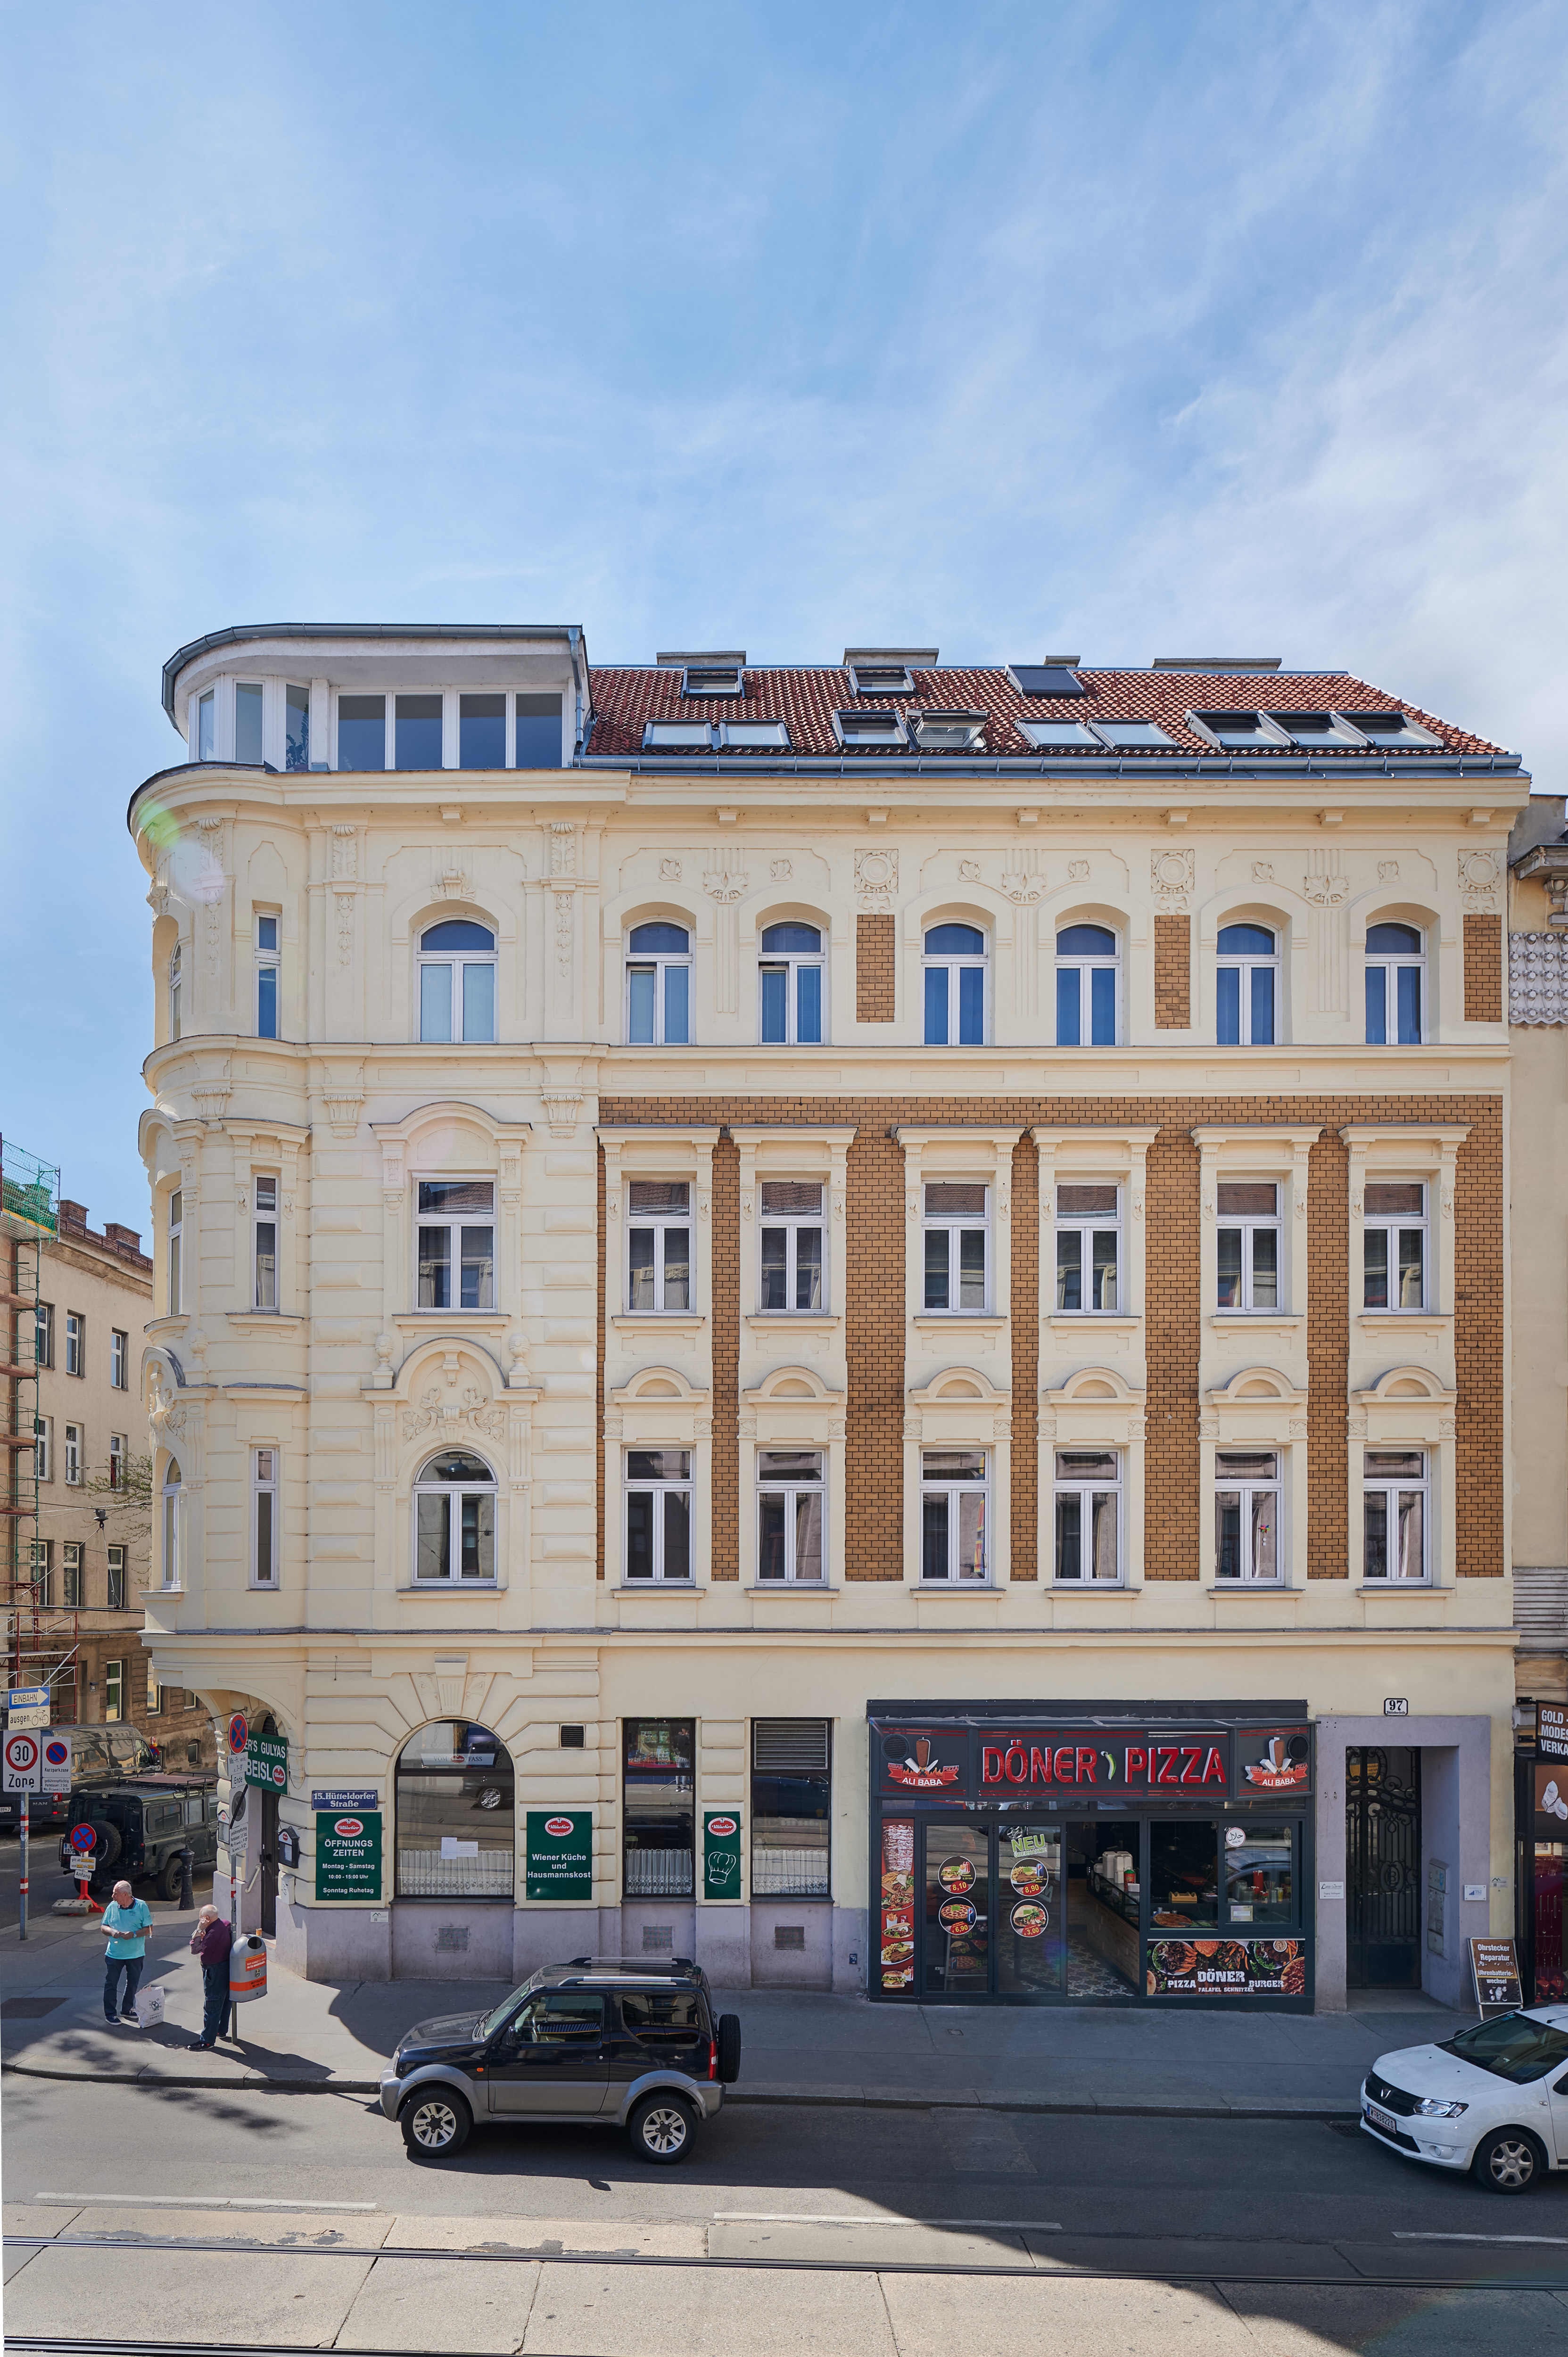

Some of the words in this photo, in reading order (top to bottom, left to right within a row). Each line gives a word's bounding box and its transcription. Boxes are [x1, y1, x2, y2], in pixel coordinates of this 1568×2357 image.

[14, 1694, 37, 1704] EINBAHN
[1389, 1700, 1403, 1711] 97
[10, 1714, 32, 1725] ausgen.
[1541, 1709, 1564, 1724] GOLD
[261, 1742, 286, 1759] GULYAS
[1541, 1739, 1568, 1756] VERKA
[15, 1745, 29, 1762] 30
[982, 1739, 1098, 1784] DÖNER
[1124, 1747, 1227, 1784] PIZZA
[246, 1759, 273, 1782] BEISL
[8, 1774, 34, 1788] Zone
[1275, 1777, 1296, 1786] BABA
[325, 1792, 375, 1800] Hütteldorfer
[1228, 1832, 1244, 1841] حلال
[324, 1838, 373, 1847] ÖFFNUNGS
[1011, 1834, 1046, 1853] NEU
[1014, 1847, 1048, 1858] ÜBERNAHME
[952, 1882, 967, 1891] 8,10
[1024, 1884, 1040, 1893] 8,90
[955, 1925, 968, 1933] 6,90
[1026, 1927, 1040, 1935] 3,00
[1480, 1953, 1510, 1962] Reparatur
[1167, 1979, 1197, 1988] PIZZA
[1197, 1969, 1245, 1983] DÖNER
[1248, 1980, 1284, 1988] BURGER
